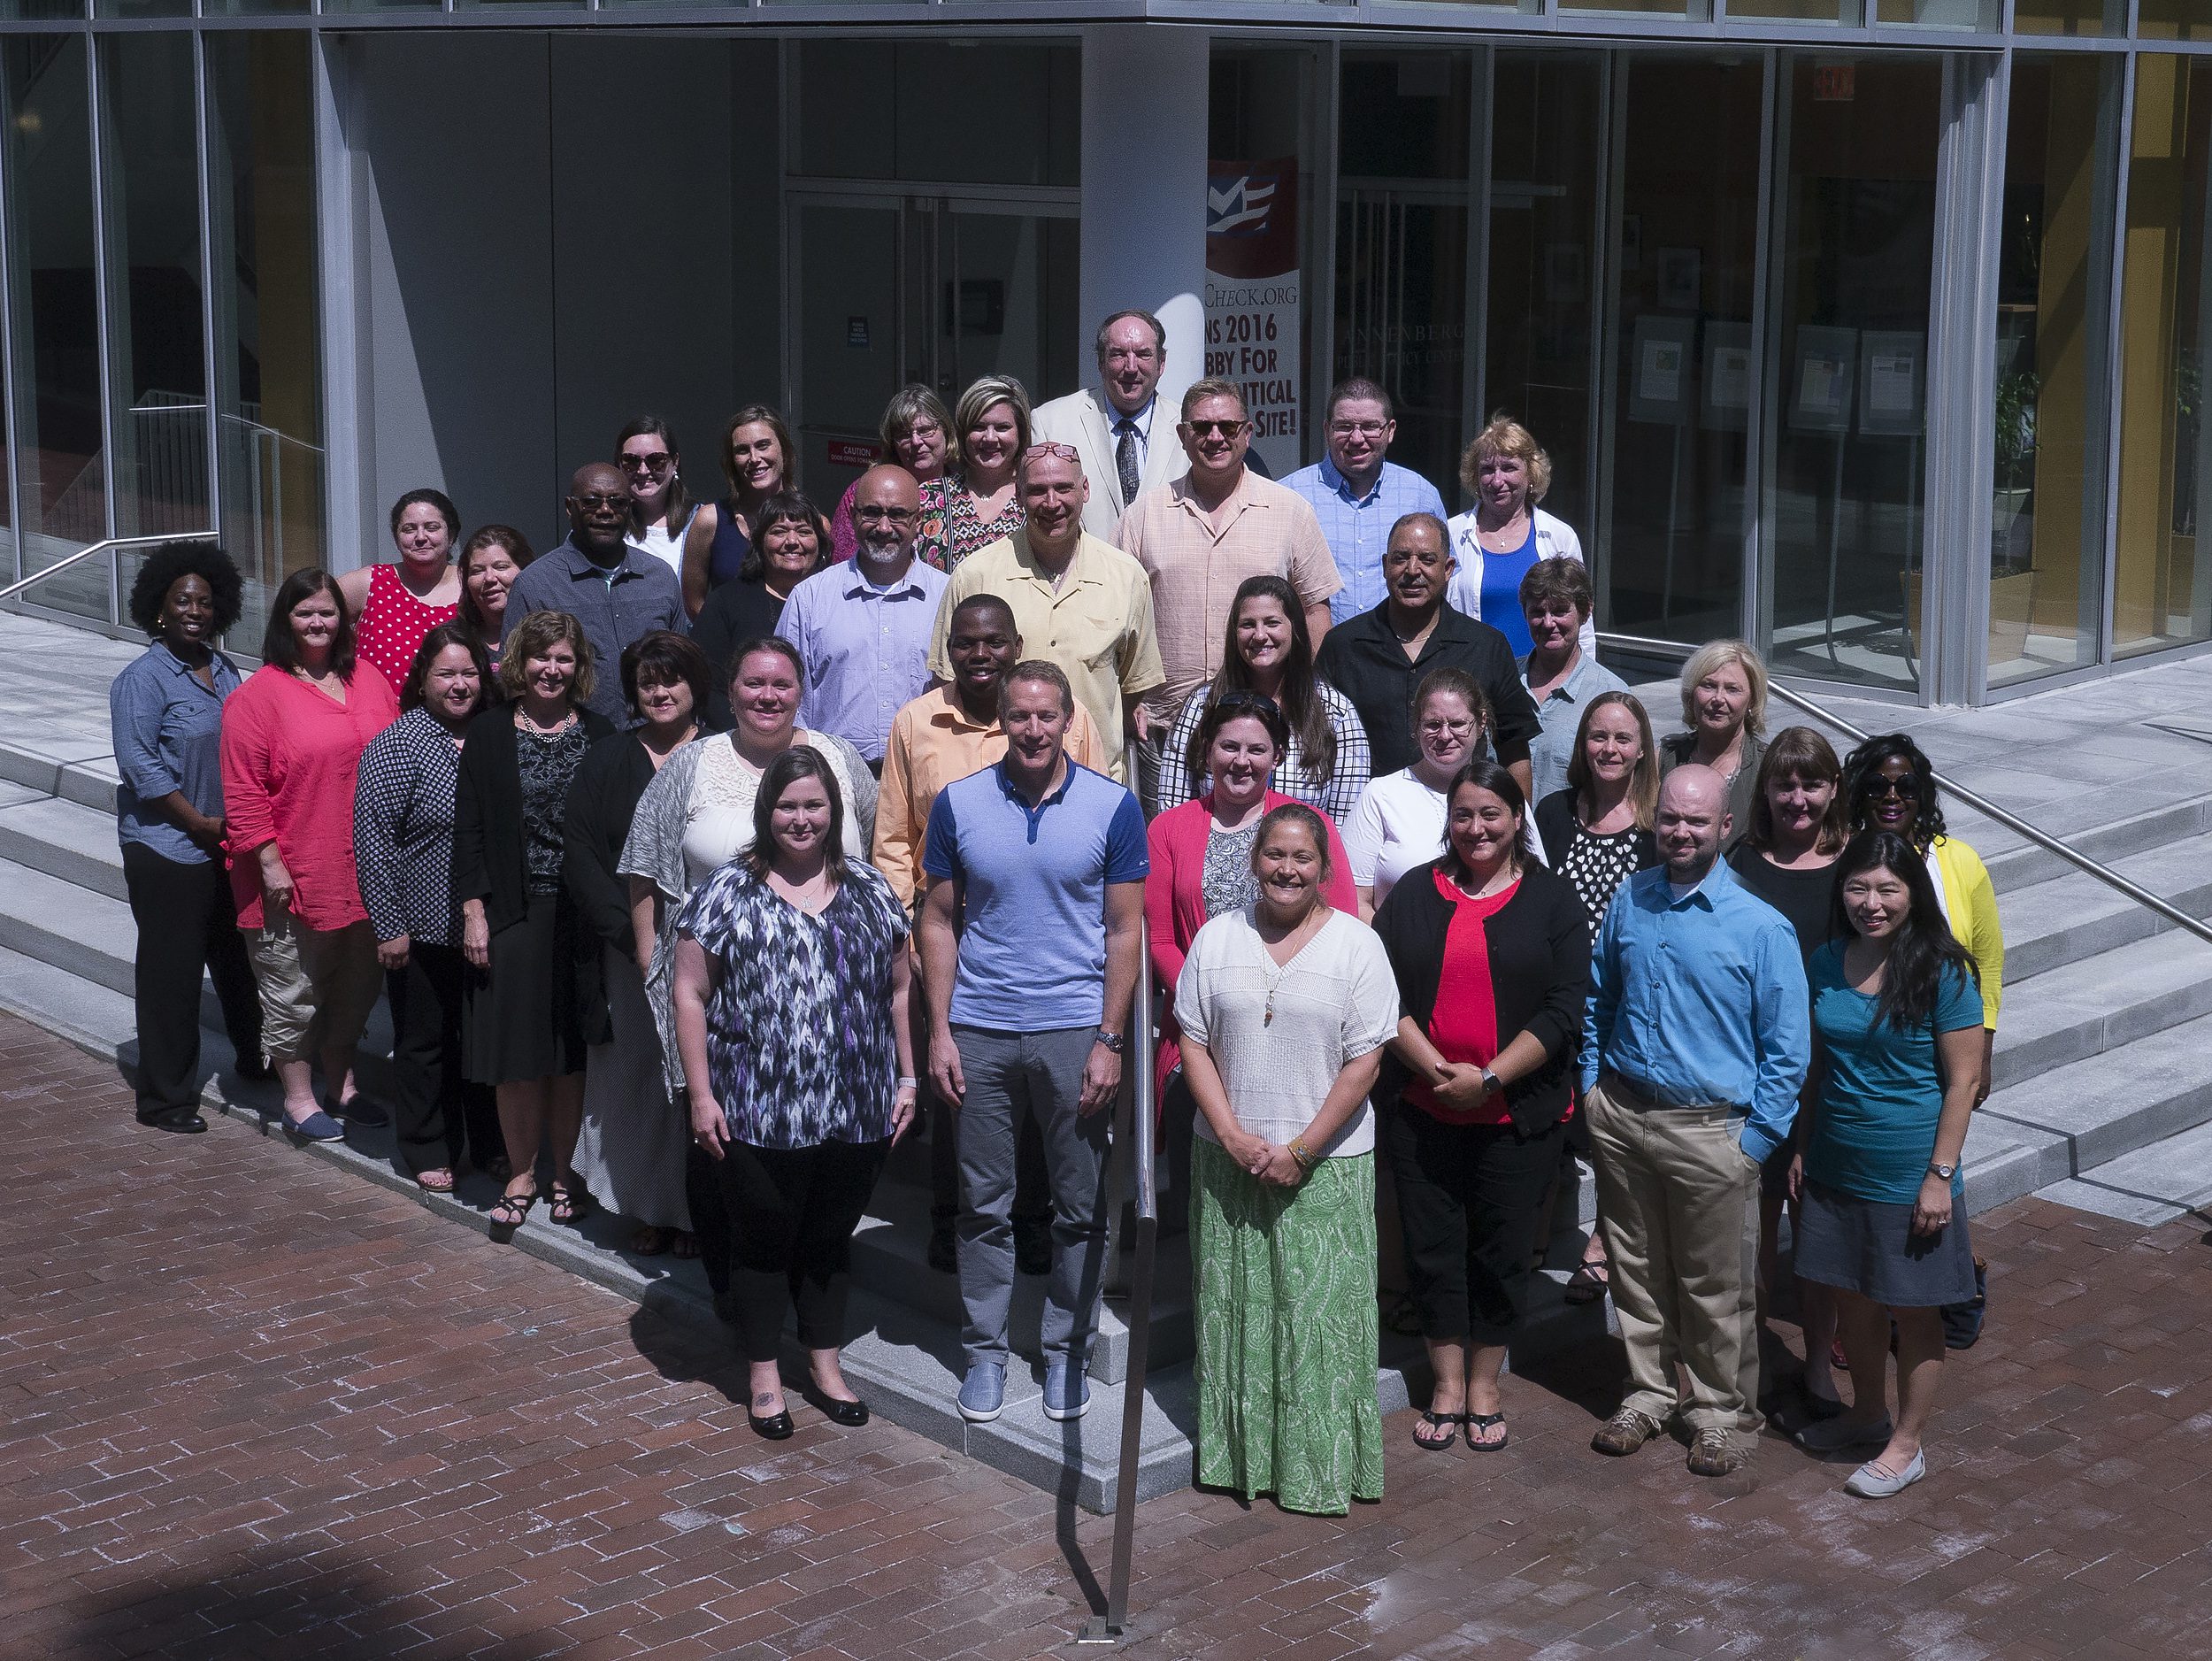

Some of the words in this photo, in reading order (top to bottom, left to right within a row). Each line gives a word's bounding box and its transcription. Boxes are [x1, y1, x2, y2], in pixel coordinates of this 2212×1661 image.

[1205, 319, 1221, 344] NS
[1225, 313, 1278, 343] 2016
[1205, 350, 1235, 376] BBY
[1240, 347, 1278, 374] FOR
[1242, 380, 1296, 406] ITICAL
[1256, 409, 1296, 438] SITE!
[843, 446, 871, 457] CAUTION
